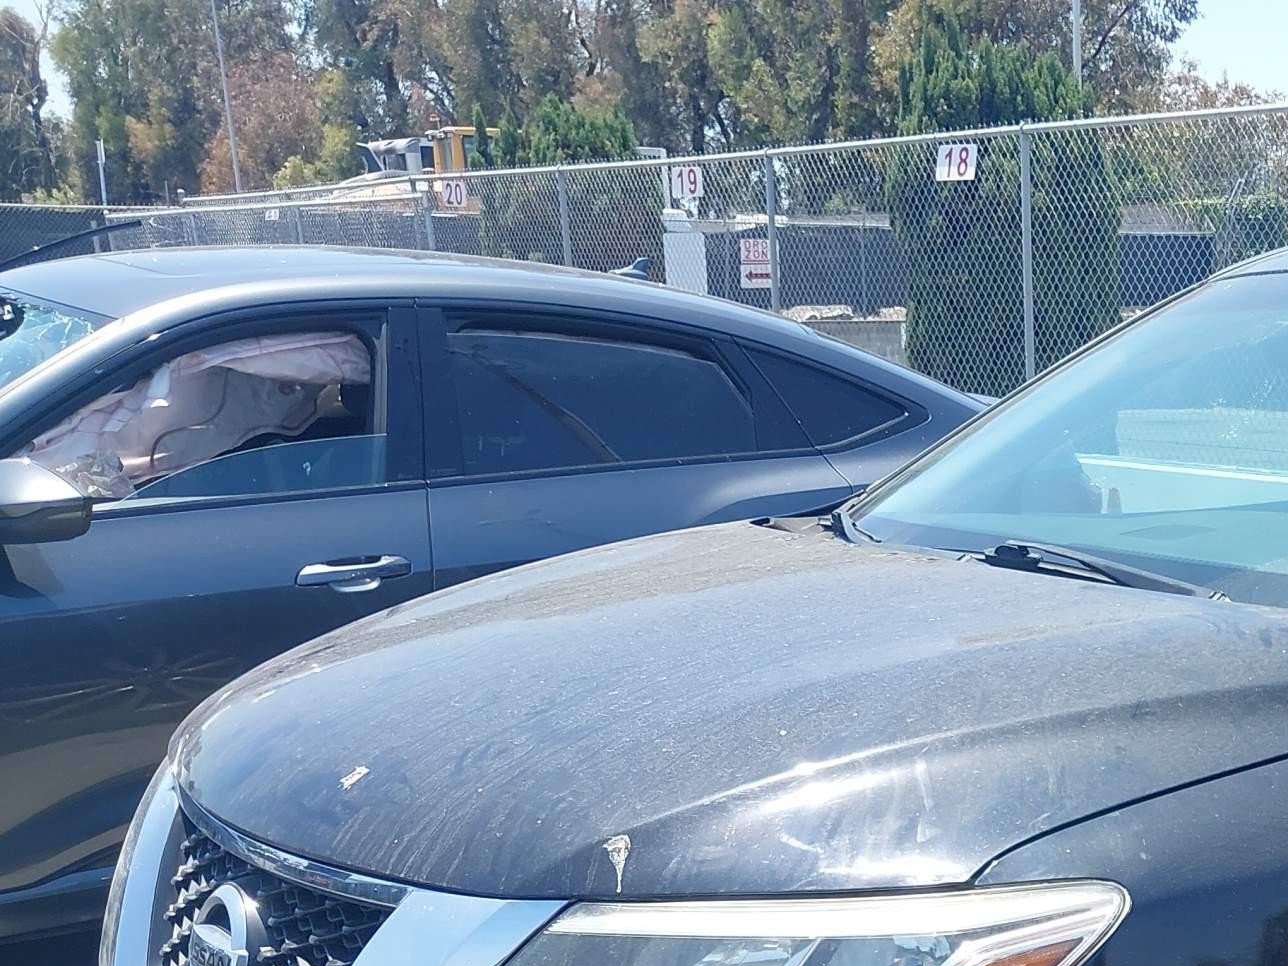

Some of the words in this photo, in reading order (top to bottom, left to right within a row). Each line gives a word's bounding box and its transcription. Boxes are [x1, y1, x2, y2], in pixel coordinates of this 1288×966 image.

[945, 146, 969, 178] 18
[677, 168, 697, 195] 19
[445, 182, 463, 206] 20
[744, 240, 768, 250] DRO
[744, 249, 768, 259] ZON
